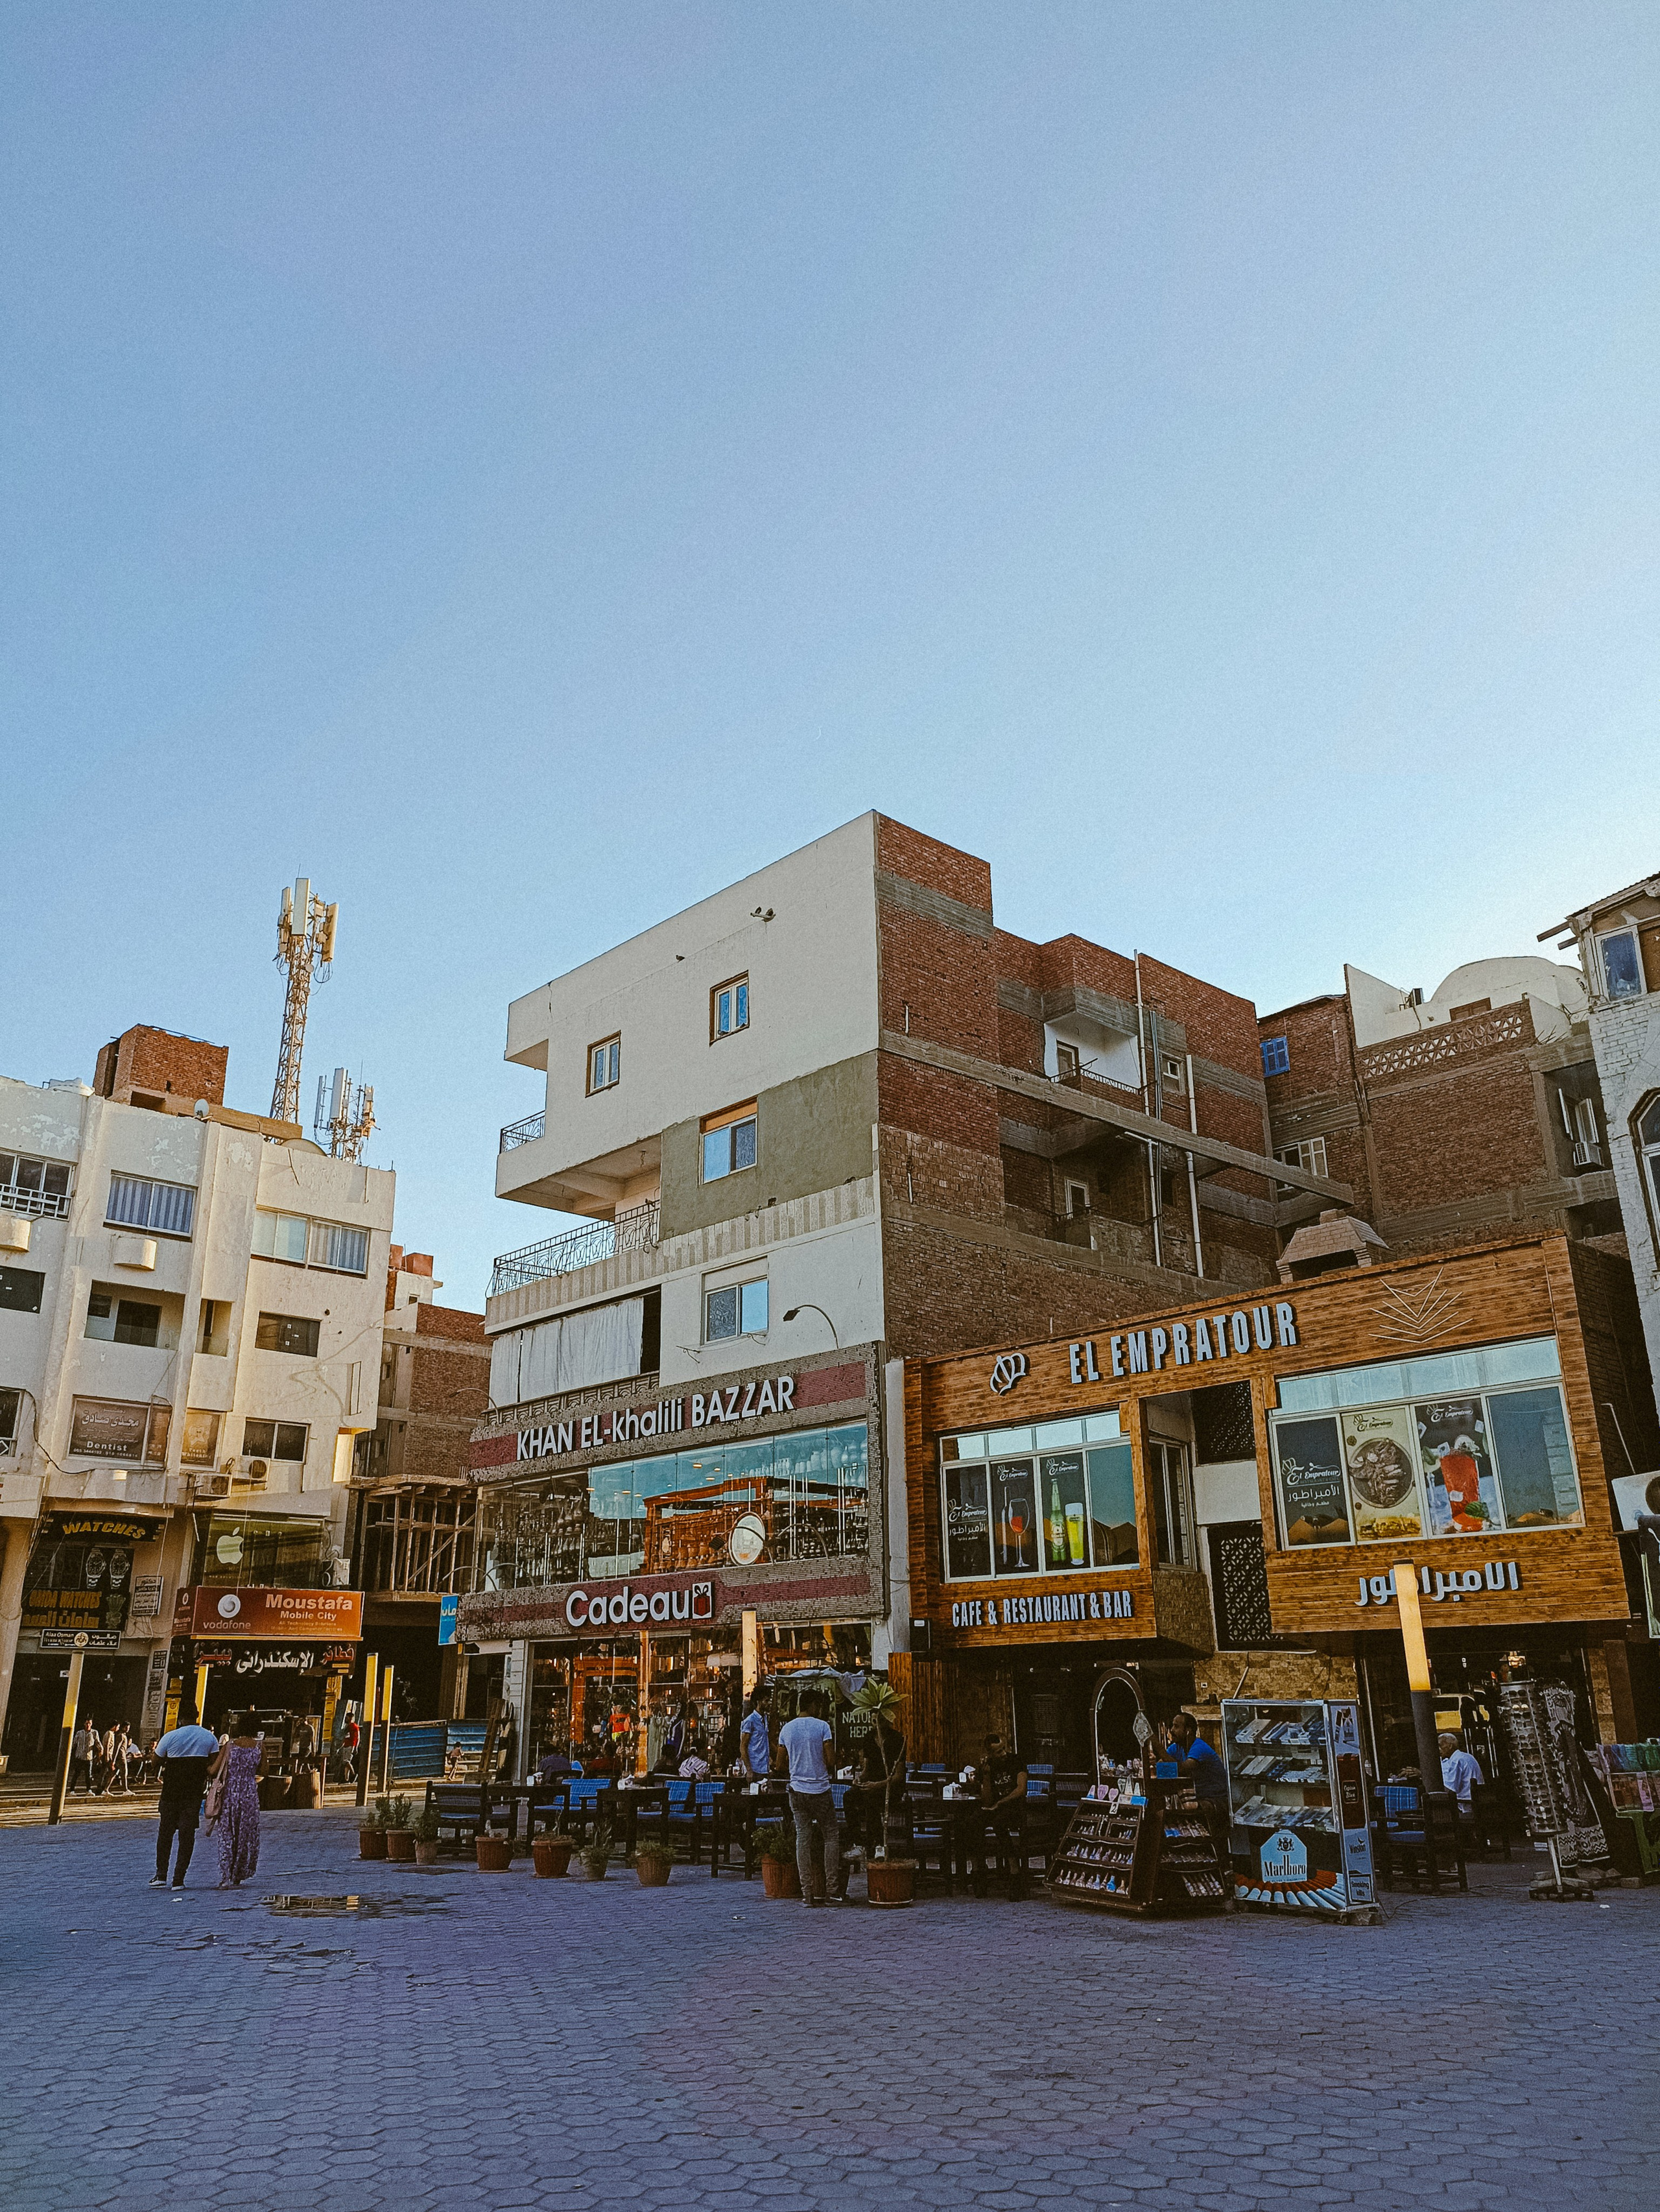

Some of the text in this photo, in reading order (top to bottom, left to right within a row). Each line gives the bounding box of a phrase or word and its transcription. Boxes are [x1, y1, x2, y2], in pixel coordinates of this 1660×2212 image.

[1069, 1302, 1296, 1384] EL EMPRATOUR
[82, 1410, 109, 1425] صادق
[517, 1376, 794, 1460] KHAN EL-khalili BAZZAR
[87, 1441, 127, 1451] Dentist
[62, 1521, 145, 1539] WATCHES
[1354, 1562, 1519, 1606] الامبراور
[60, 1591, 102, 1608] WATCHES
[265, 1593, 353, 1610] Moustafa
[280, 1611, 337, 1621] Mobile City
[952, 1590, 1132, 1627] CAFE & RESTAURANT & BAR
[203, 1620, 251, 1630] vodafone
[1264, 1855, 1305, 1876] Marlboro
[1351, 1881, 1370, 1890] Smoking
